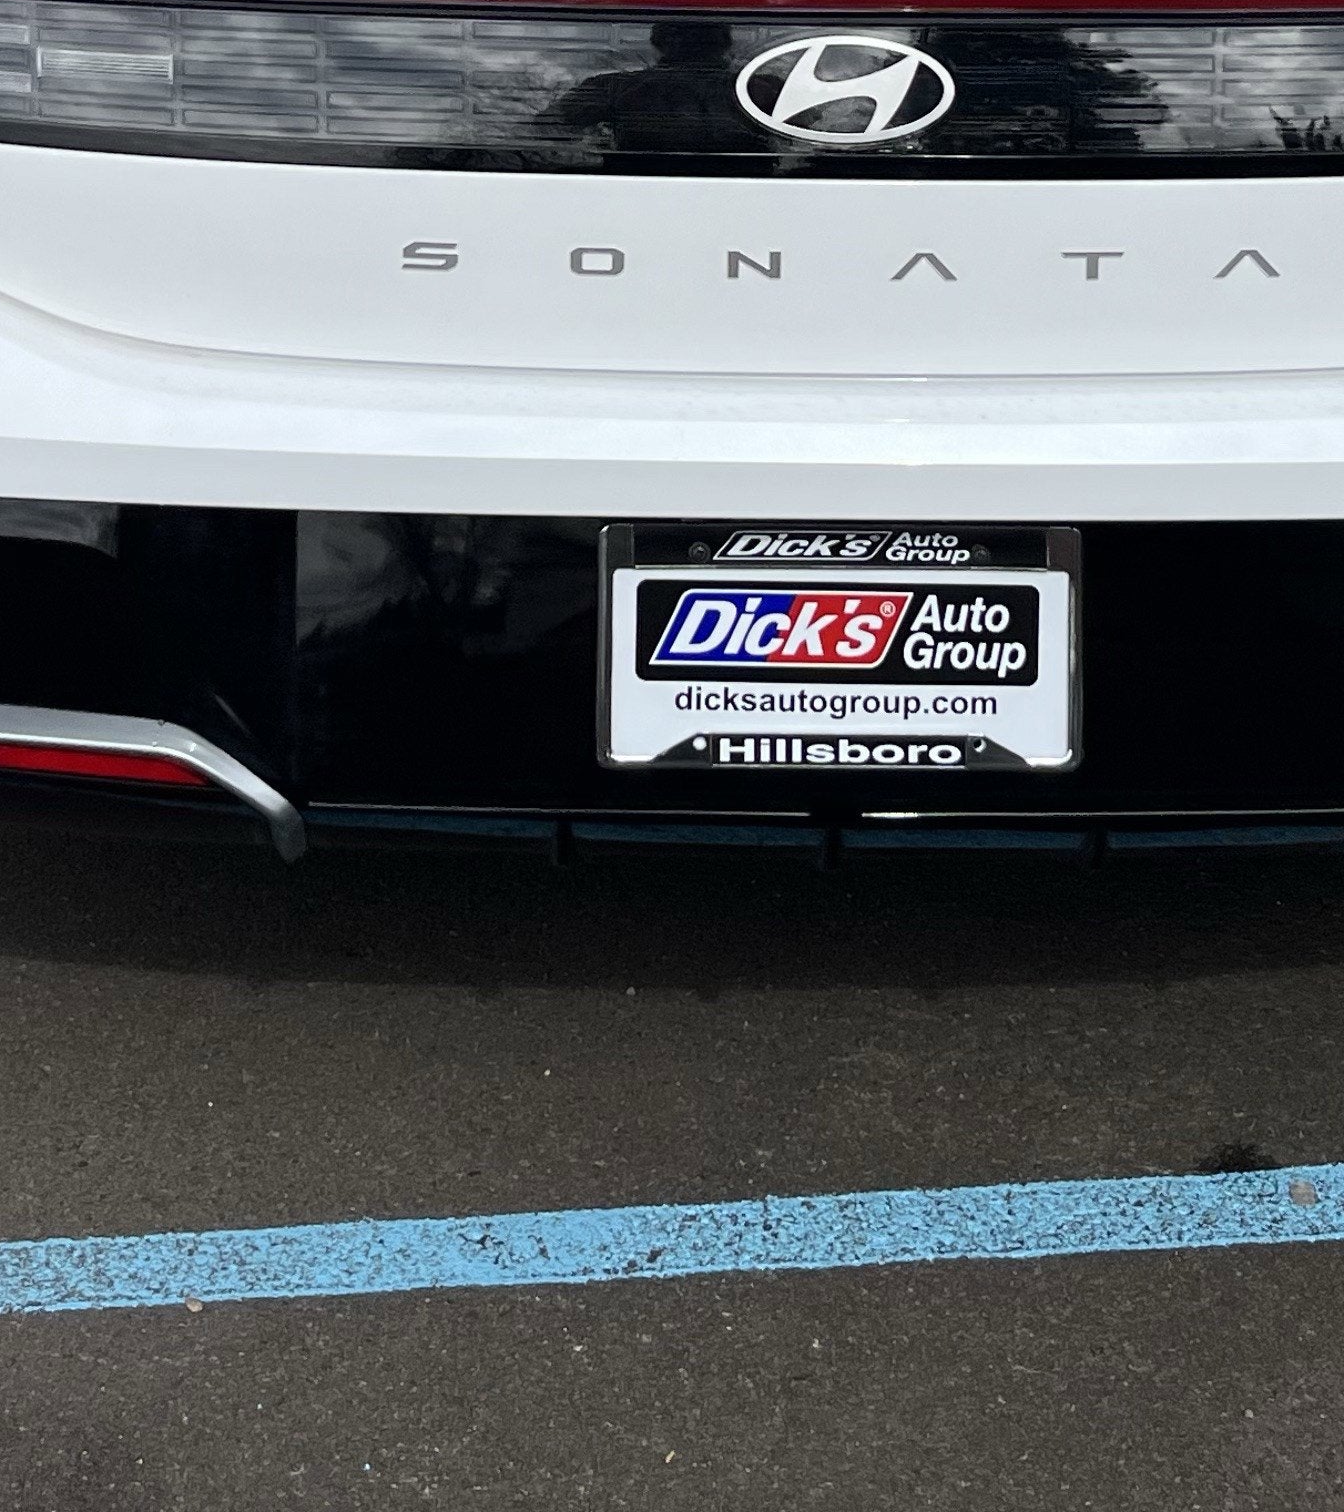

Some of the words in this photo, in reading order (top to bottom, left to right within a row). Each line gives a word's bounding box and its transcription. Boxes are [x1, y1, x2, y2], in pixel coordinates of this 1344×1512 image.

[401, 241, 1281, 280] SONATA
[727, 534, 872, 557] Dick's
[885, 545, 971, 565] Group
[893, 532, 959, 548] Auto
[669, 597, 883, 657] Dick's
[910, 595, 1010, 634] Auto
[902, 631, 1028, 678] Group
[674, 686, 998, 720] dicksautogroup.com
[718, 738, 963, 765] Hillsboro
